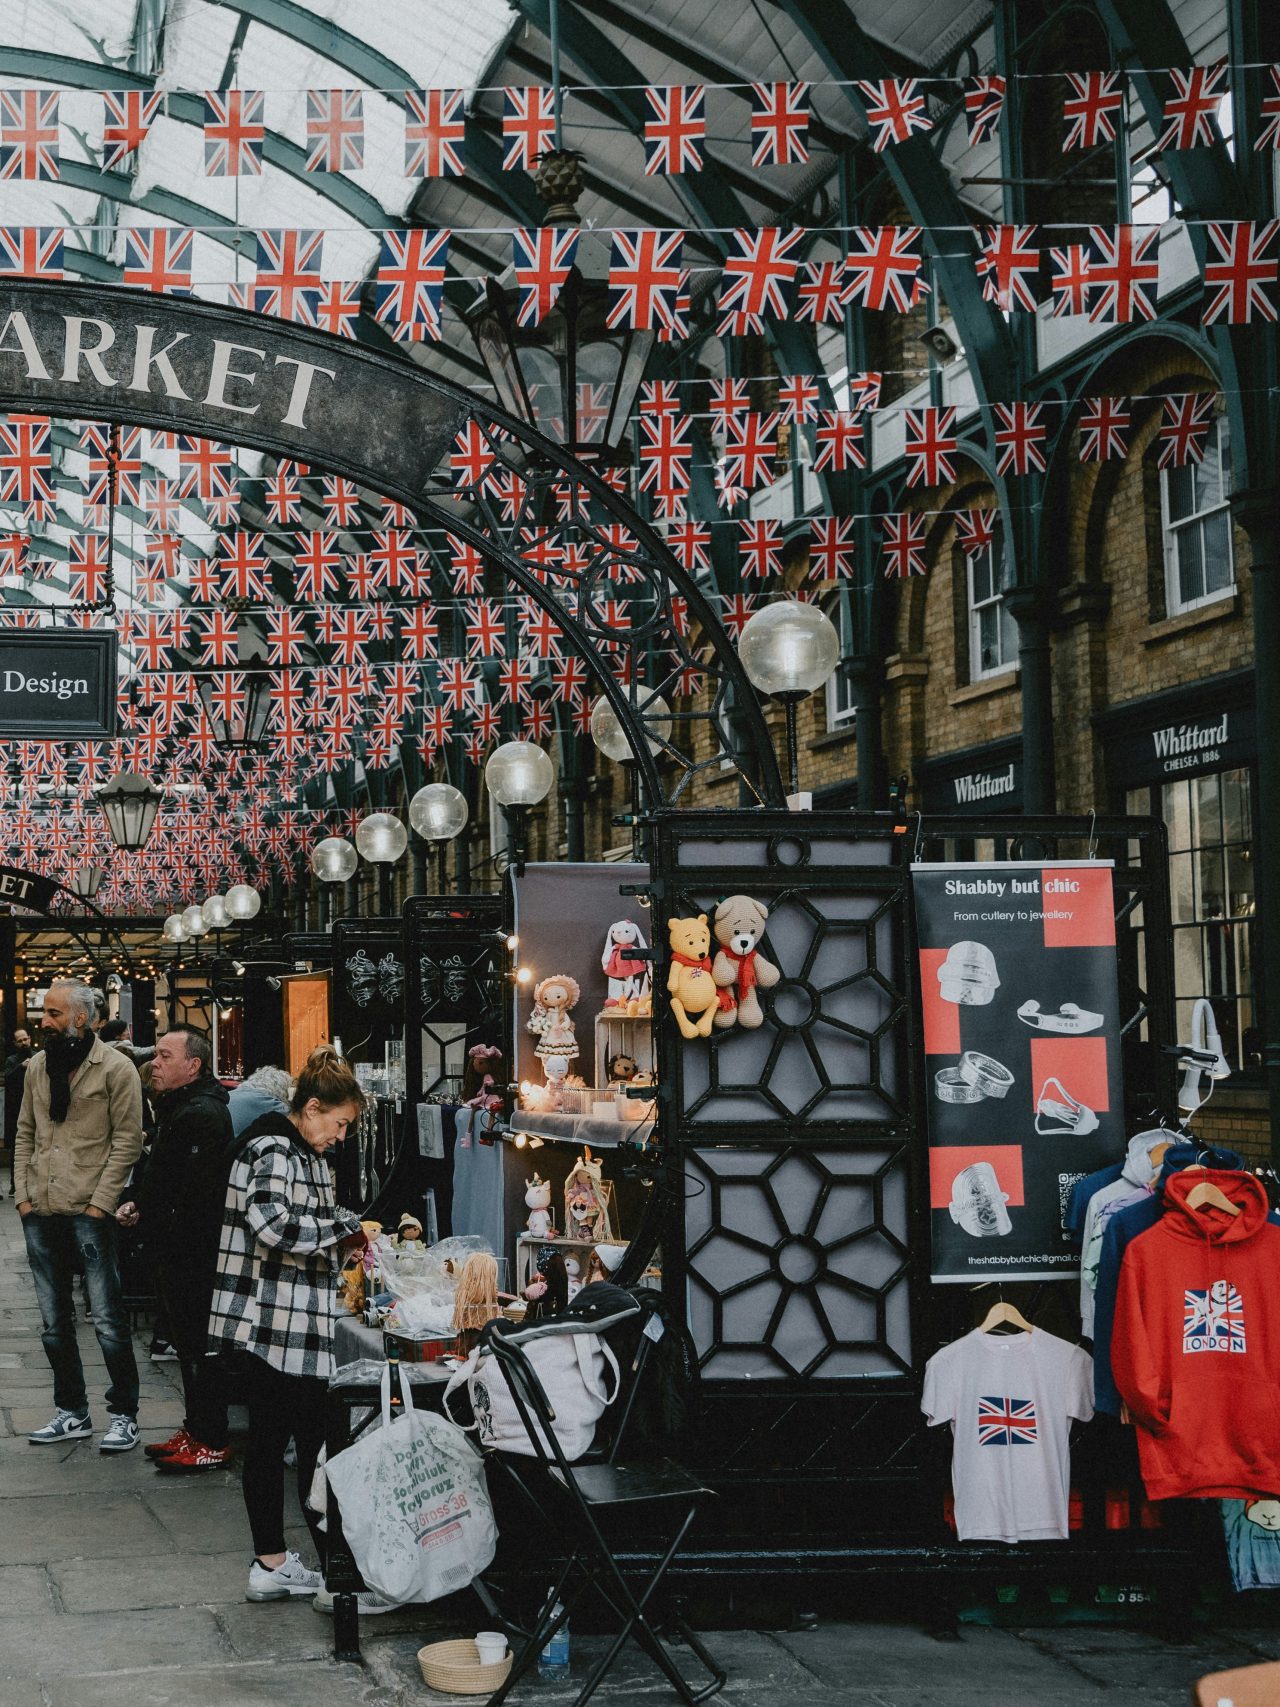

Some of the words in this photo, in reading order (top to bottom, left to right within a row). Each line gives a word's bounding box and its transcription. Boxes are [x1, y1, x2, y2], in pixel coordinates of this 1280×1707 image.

[3, 670, 89, 700] Design
[1152, 713, 1229, 758] Whittard
[1163, 755, 1199, 772] CHELSEA
[1202, 749, 1220, 764] 1886
[953, 763, 1015, 804] Whittard
[944, 879, 1007, 897] Shabby
[1011, 879, 1040, 894] but
[1044, 878, 1080, 893] chic
[953, 911, 979, 921] From
[980, 910, 1015, 922] cutlery
[1017, 911, 1028, 920] to
[1029, 910, 1073, 922] jewellery
[1185, 1337, 1244, 1351] LONDON
